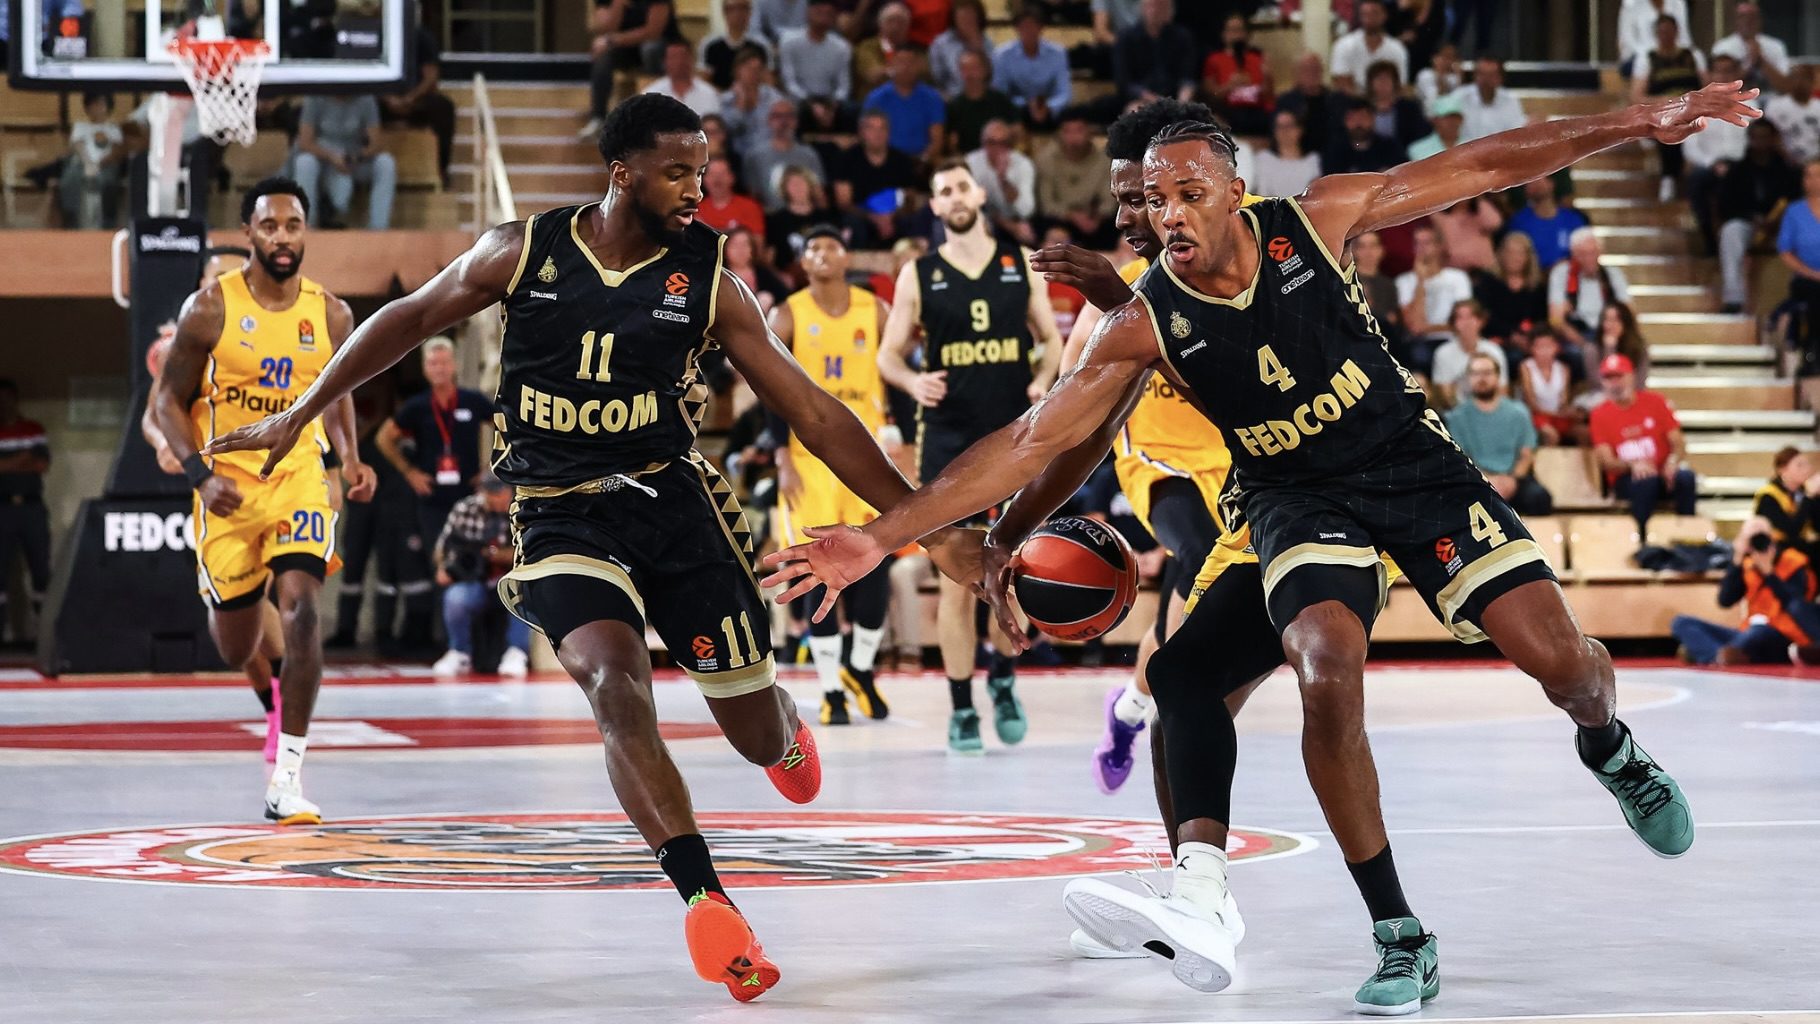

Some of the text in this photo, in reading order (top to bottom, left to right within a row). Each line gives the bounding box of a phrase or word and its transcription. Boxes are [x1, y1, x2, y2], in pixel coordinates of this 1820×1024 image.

[530, 290, 558, 301] SPALDING
[970, 299, 990, 333] 9
[576, 330, 615, 382] 11
[824, 355, 843, 379] 14
[941, 337, 1019, 367] FEDCOM
[1180, 339, 1207, 359] SPALDING
[259, 356, 293, 389] 20
[1257, 344, 1297, 393] 4
[520, 384, 658, 435] FEDCOM
[1233, 358, 1371, 457] FEDCOM
[104, 512, 197, 551] FEDC
[293, 510, 325, 543] 20
[1468, 501, 1509, 549] 4
[721, 610, 761, 669] 11
